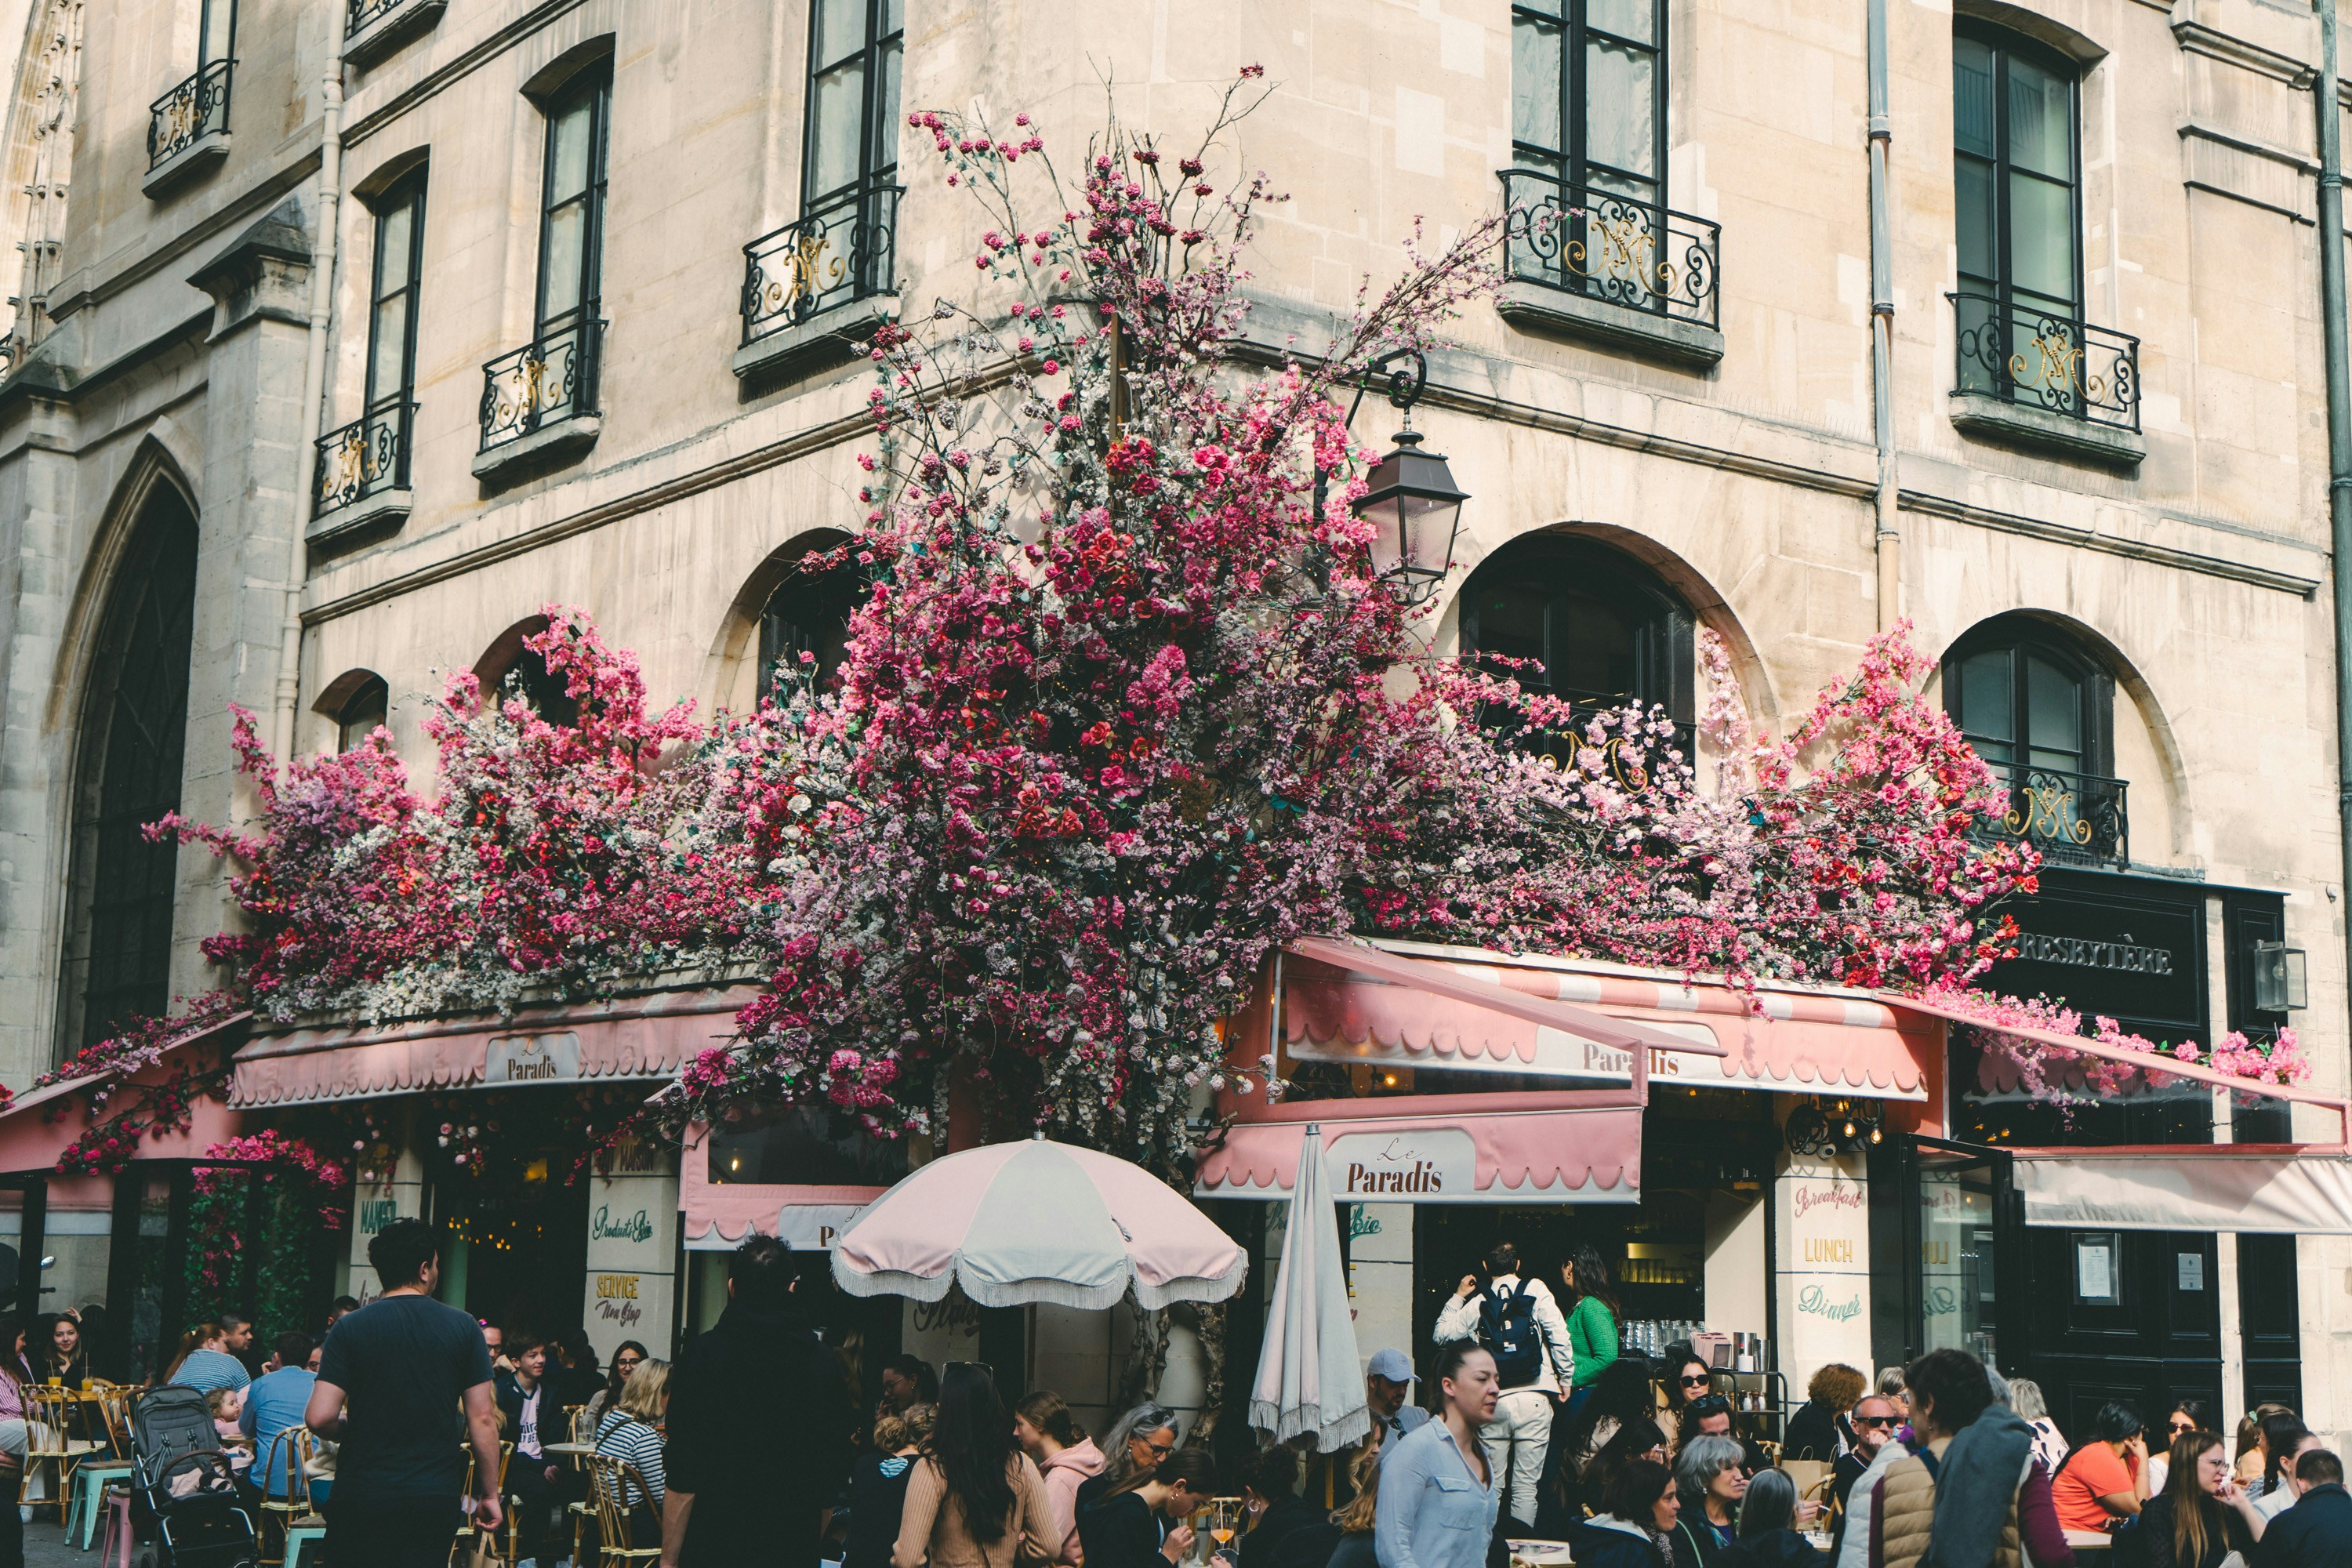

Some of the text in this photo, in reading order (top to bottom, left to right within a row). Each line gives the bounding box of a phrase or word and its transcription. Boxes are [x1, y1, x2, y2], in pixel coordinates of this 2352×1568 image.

[521, 1036, 544, 1057] Le
[506, 1055, 557, 1080] Paradis
[1376, 1138, 1425, 1161] Le
[1346, 1160, 1443, 1193] Paradis
[1795, 1185, 1862, 1218] Breakfast
[593, 1203, 653, 1243] Produits Bio
[1805, 1238, 1853, 1262] LUNCH
[597, 1275, 639, 1299] SERVICE
[595, 1299, 641, 1327] Non Stop
[1798, 1284, 1862, 1323] Dinner
